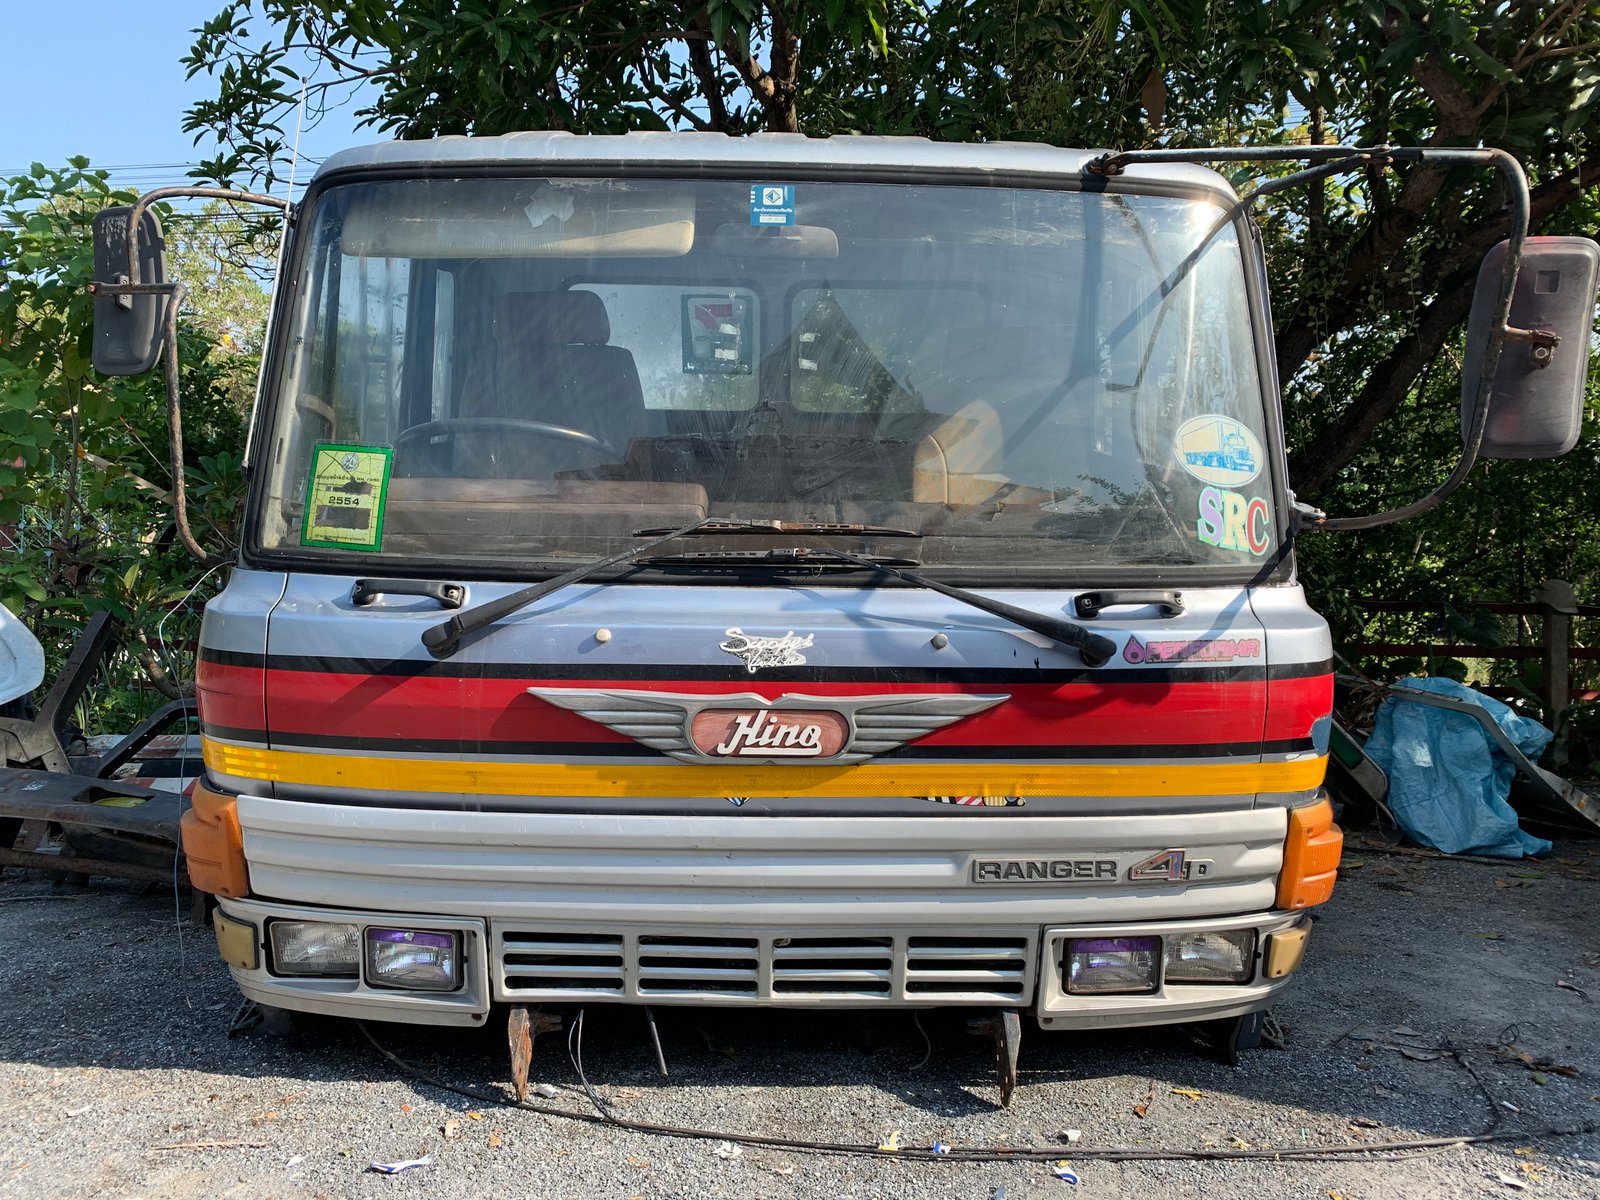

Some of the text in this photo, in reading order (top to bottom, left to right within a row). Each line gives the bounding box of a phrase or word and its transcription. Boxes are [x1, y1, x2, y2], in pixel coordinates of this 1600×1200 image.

[328, 496, 360, 506] 2554
[1197, 486, 1270, 556] SRC
[717, 709, 822, 755] Hino
[978, 861, 1117, 880] RANGER
